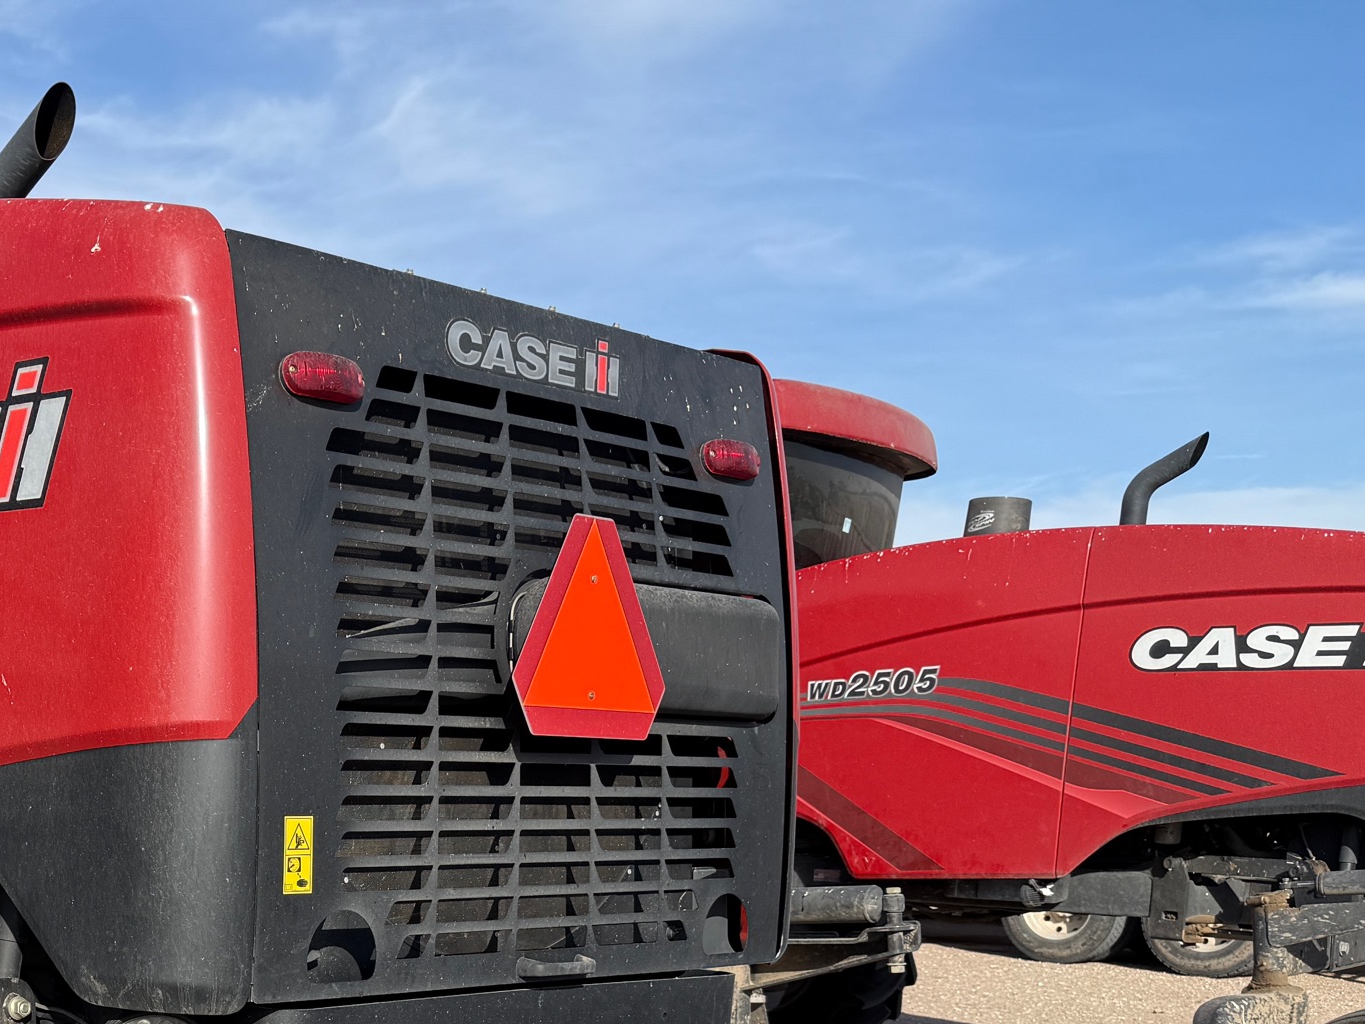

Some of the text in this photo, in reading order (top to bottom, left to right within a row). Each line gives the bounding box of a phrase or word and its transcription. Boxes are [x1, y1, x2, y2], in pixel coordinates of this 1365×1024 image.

[446, 320, 578, 388] CASE
[1130, 623, 1362, 671] CASE
[807, 665, 941, 701] WD2505
